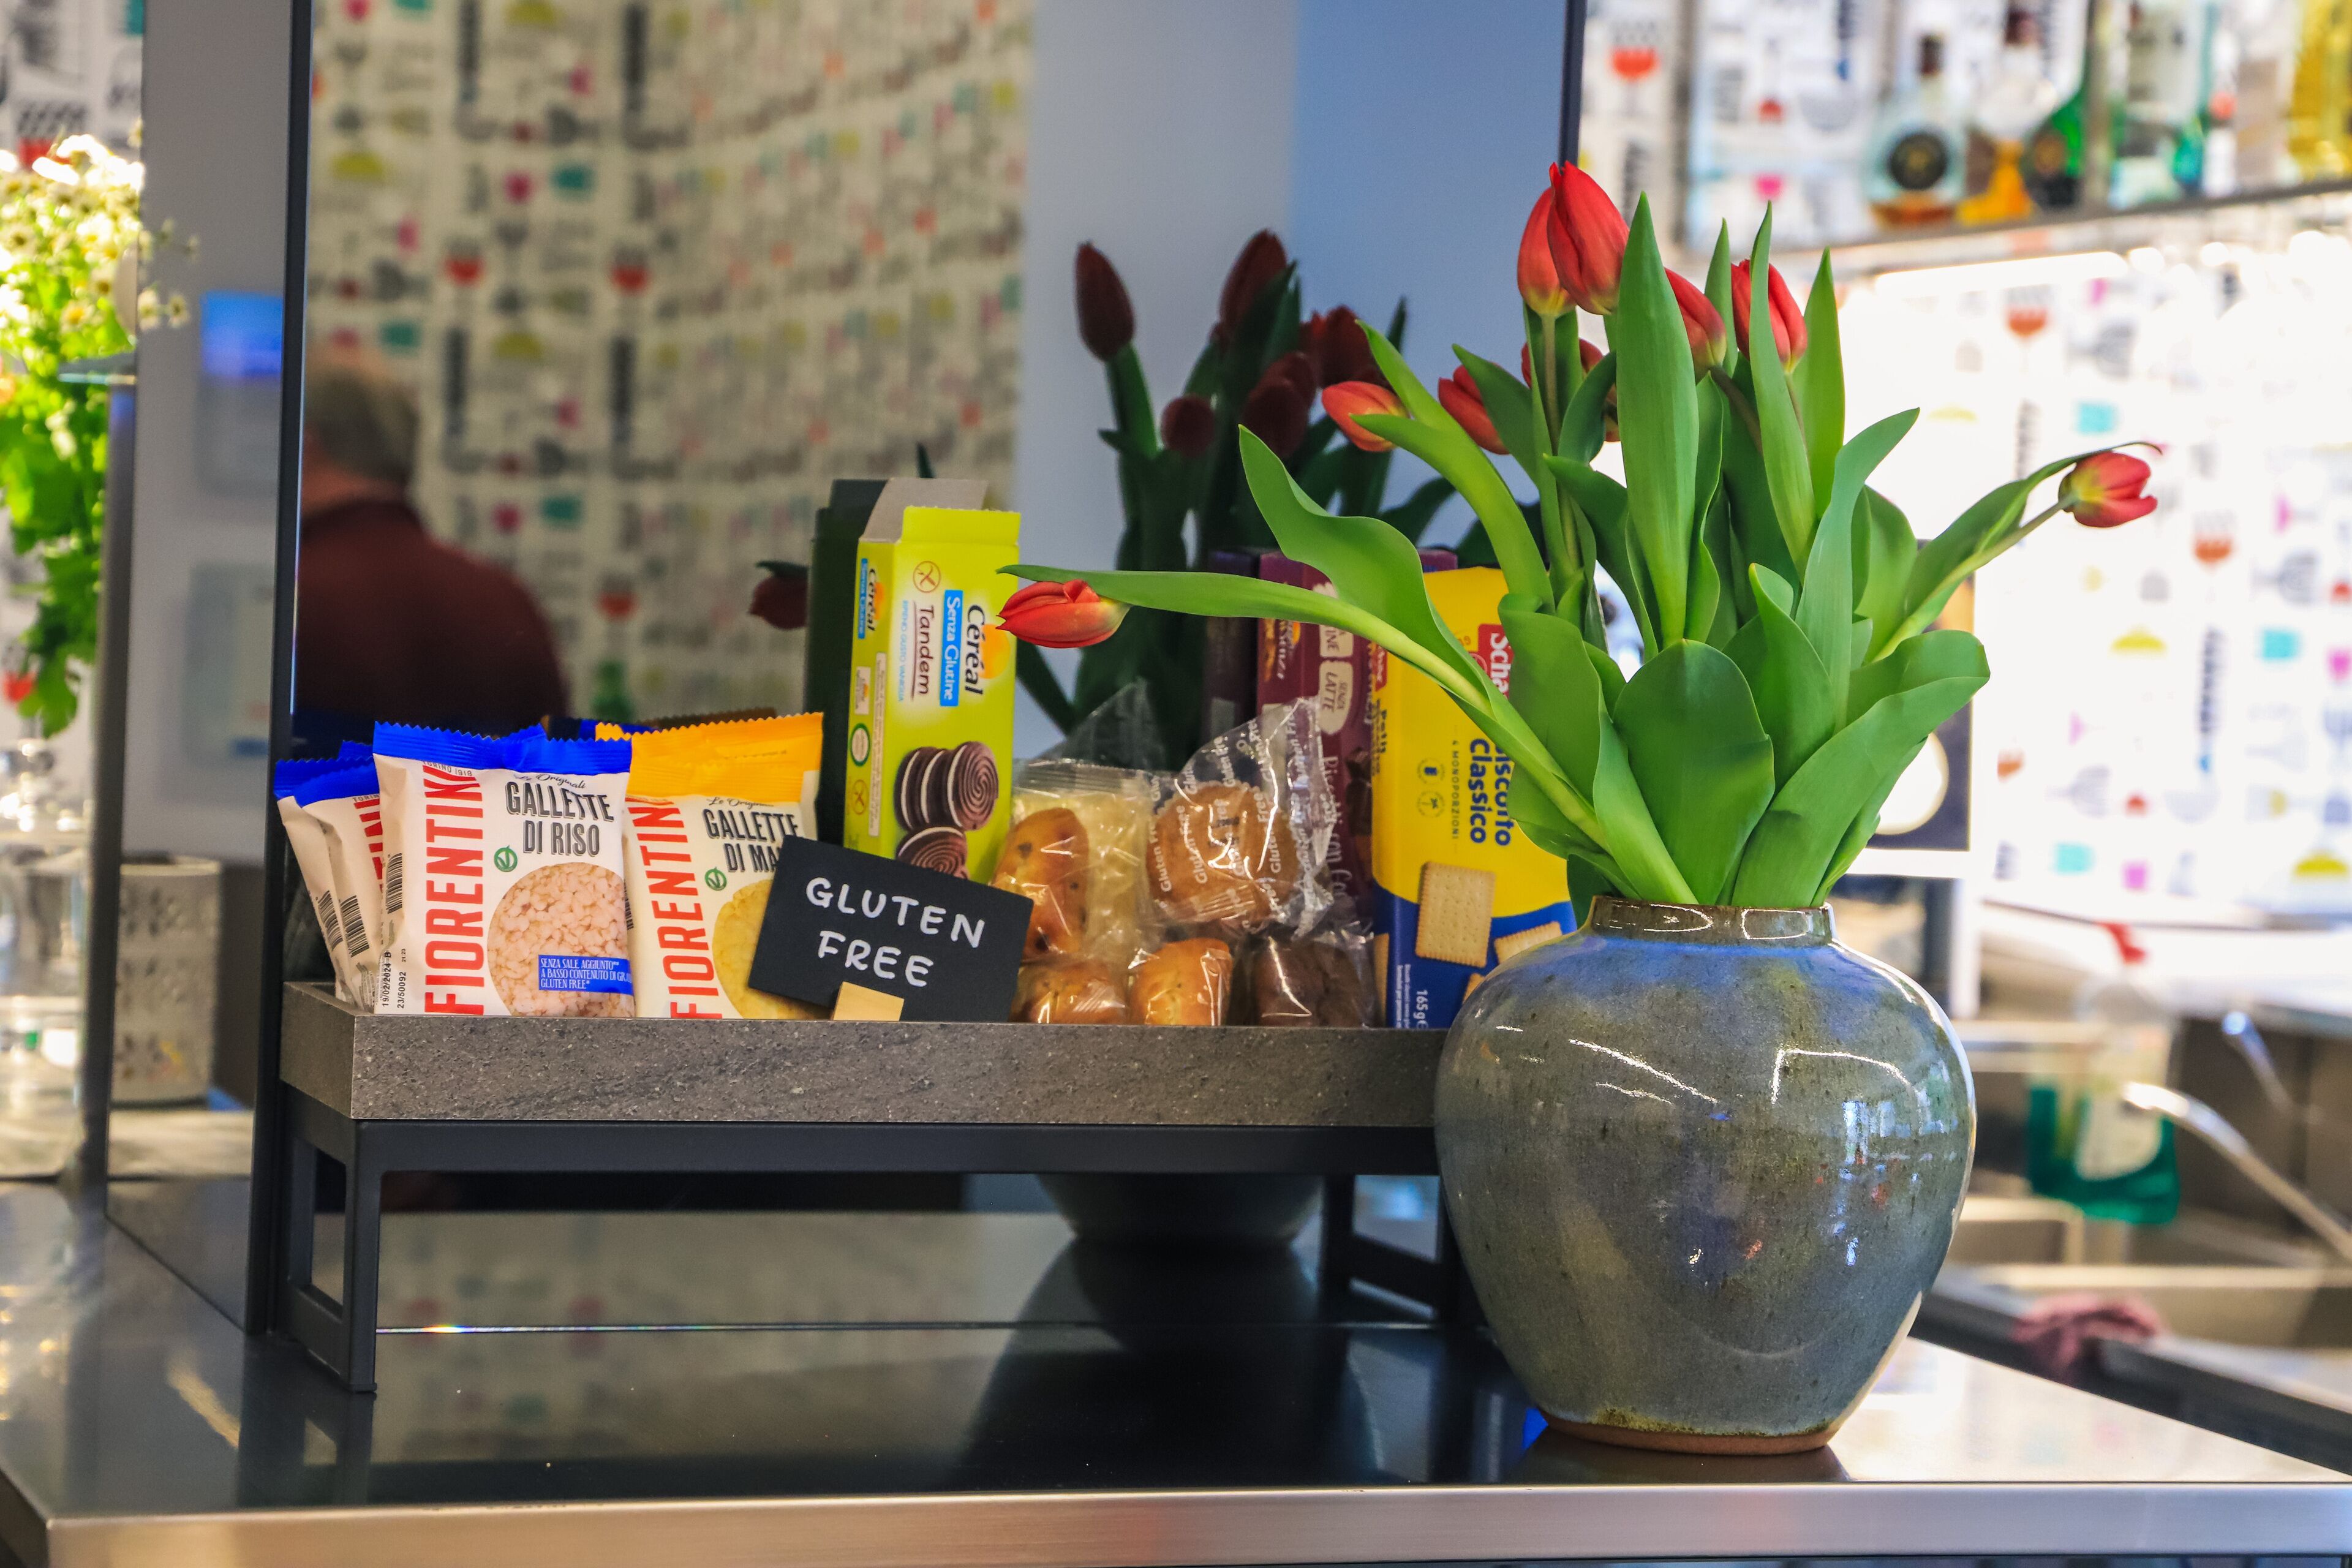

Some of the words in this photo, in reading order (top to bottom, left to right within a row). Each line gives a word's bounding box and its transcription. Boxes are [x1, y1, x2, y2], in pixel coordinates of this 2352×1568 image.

[946, 597, 961, 642] Senza
[918, 605, 935, 695] Tandem
[965, 605, 986, 695] Céréal
[944, 644, 960, 700] Glutine
[1324, 671, 1338, 714] LATTE
[455, 767, 473, 777] 1918
[536, 773, 586, 789] Originali
[1468, 738, 1493, 843] Classico
[505, 782, 615, 823] GALLETTE
[1254, 792, 1269, 824] Free
[523, 820, 543, 854] DI
[551, 822, 600, 858] RISO
[701, 808, 799, 843] GALLETTE
[723, 842, 746, 873] DI
[1153, 846, 1172, 892] Gluten
[423, 764, 484, 1015] FIORENTINI
[805, 876, 986, 949] GLUTEN
[540, 957, 560, 969] SENZA
[562, 959, 579, 970] SALE
[540, 968, 546, 978] A
[548, 968, 568, 979] BASSO
[569, 969, 608, 981] CONTENUTO
[609, 971, 616, 981] DI
[818, 930, 934, 987] FREE
[382, 963, 392, 1007] 19/02/2024
[397, 971, 407, 1009] 23/50092
[540, 978, 567, 989] GLUTEN
